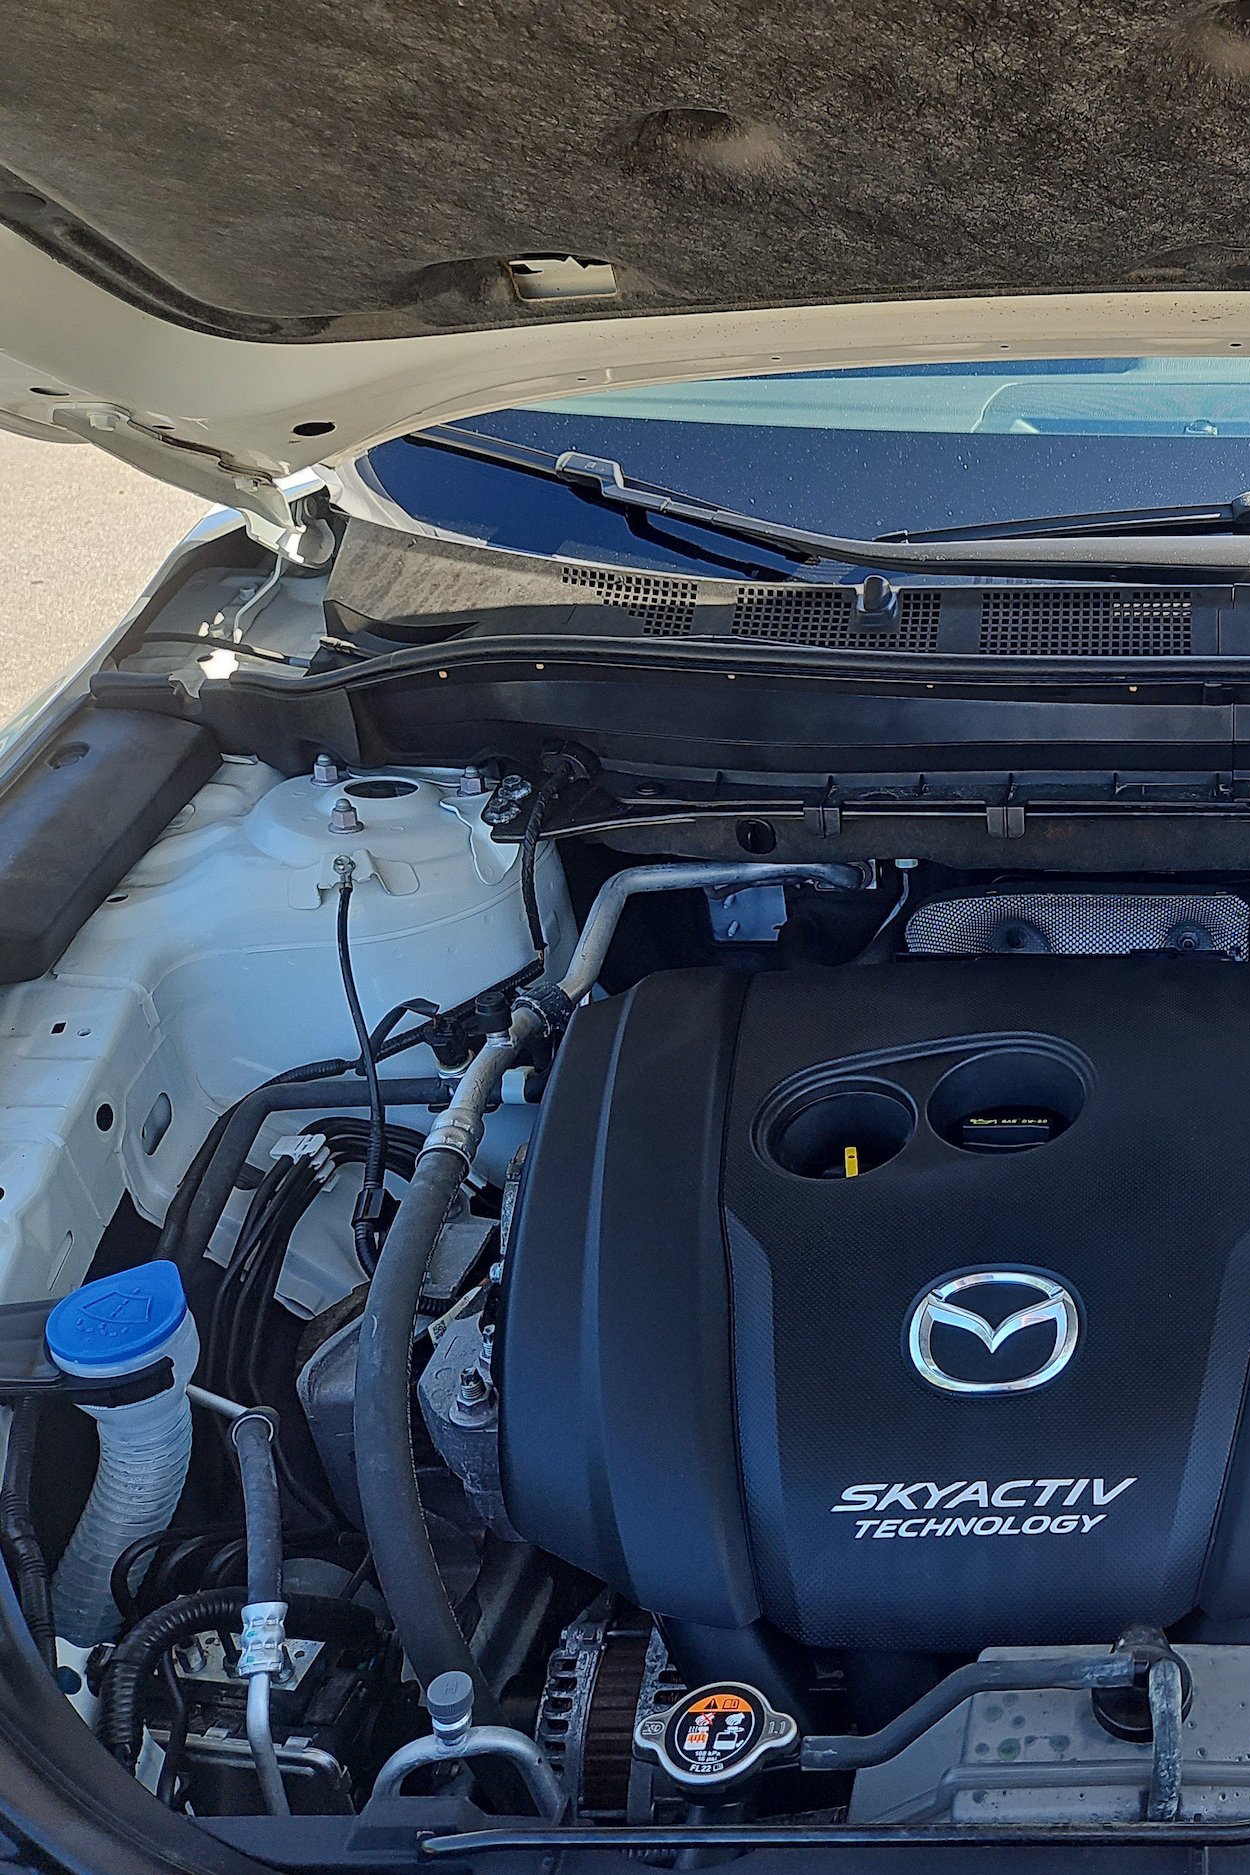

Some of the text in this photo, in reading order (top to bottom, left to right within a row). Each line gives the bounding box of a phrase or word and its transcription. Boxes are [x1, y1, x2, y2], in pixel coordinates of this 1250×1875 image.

[830, 1477, 1138, 1512] SKYACTIV
[854, 1514, 1107, 1539] TECHNOLOGY
[768, 1719, 786, 1735] 1.1
[689, 1764, 712, 1773] FL22
